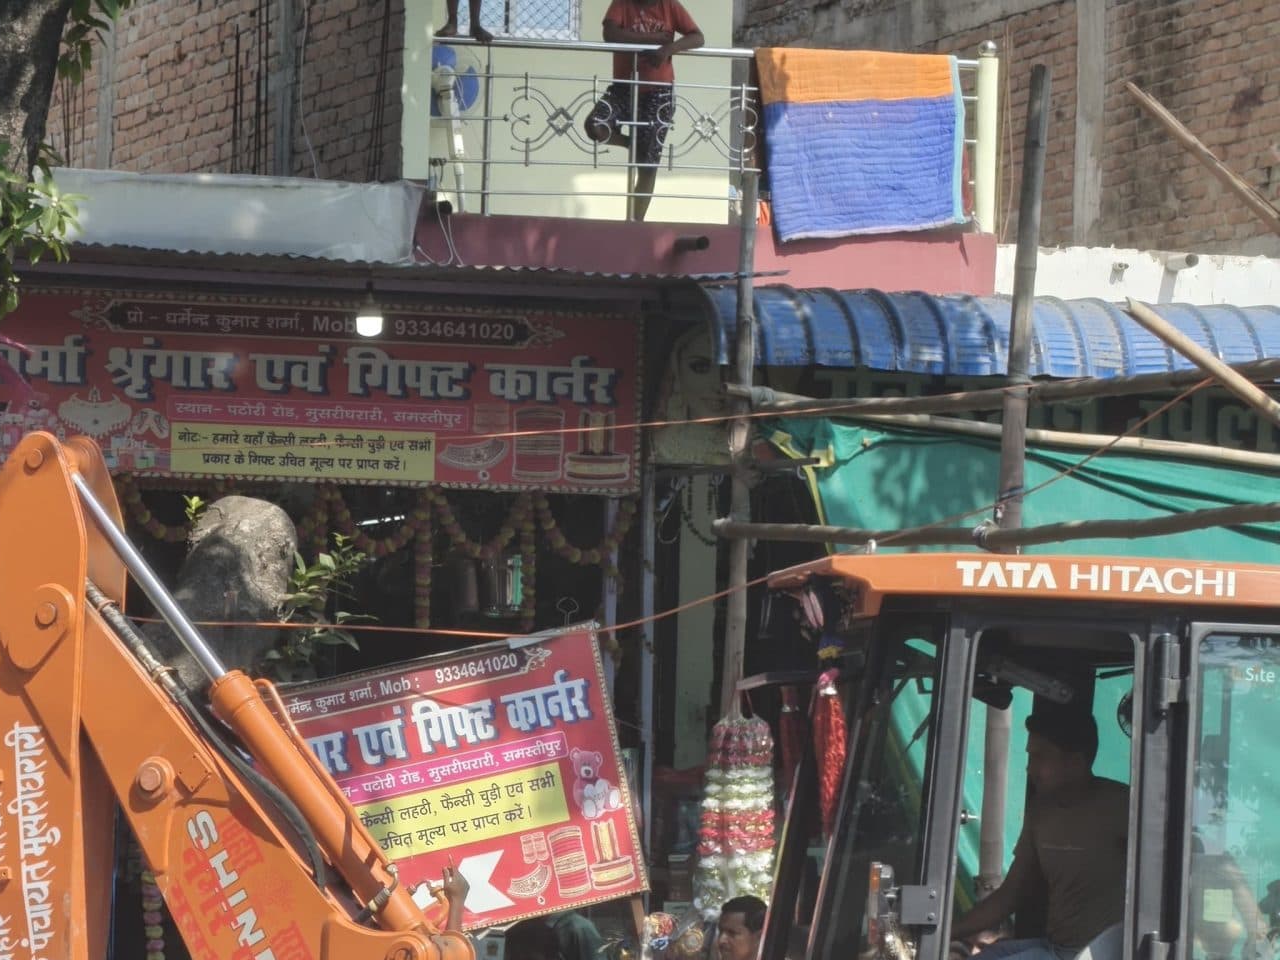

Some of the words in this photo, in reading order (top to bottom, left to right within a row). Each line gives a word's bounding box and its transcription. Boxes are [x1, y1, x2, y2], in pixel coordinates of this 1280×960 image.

[216, 315, 260, 333] कुमार
[395, 320, 515, 341] 9334641020
[249, 344, 331, 393] एवं
[343, 346, 471, 399] गिफ्ट
[483, 354, 616, 403] कार्नर
[212, 429, 240, 445] हमारे
[392, 409, 464, 429] समस्तीपुर
[202, 452, 231, 466] प्रकार
[234, 450, 246, 466] के
[248, 450, 276, 467] गिफ्ट
[310, 455, 335, 472] मूल्य
[338, 457, 353, 469] पर
[357, 458, 380, 470] प्राप्त
[956, 560, 1057, 590] TATA
[1070, 563, 1236, 597] HITACHI
[315, 692, 347, 713] कुमार
[434, 653, 519, 684] 9334641020
[1245, 667, 1276, 683] Site
[352, 705, 408, 765] एवं
[411, 698, 497, 753] गिफ्ट
[500, 669, 590, 732] कार्नर
[502, 739, 562, 763] समस्तीपुर
[4, 721, 62, 860] मुसरीघरारी
[440, 791, 476, 811] फैन्सी
[527, 770, 556, 792] सभी
[416, 824, 447, 847] मूल्य
[450, 819, 469, 835] पर
[471, 812, 501, 831] प्राप्त
[20, 859, 56, 955] पंचायत
